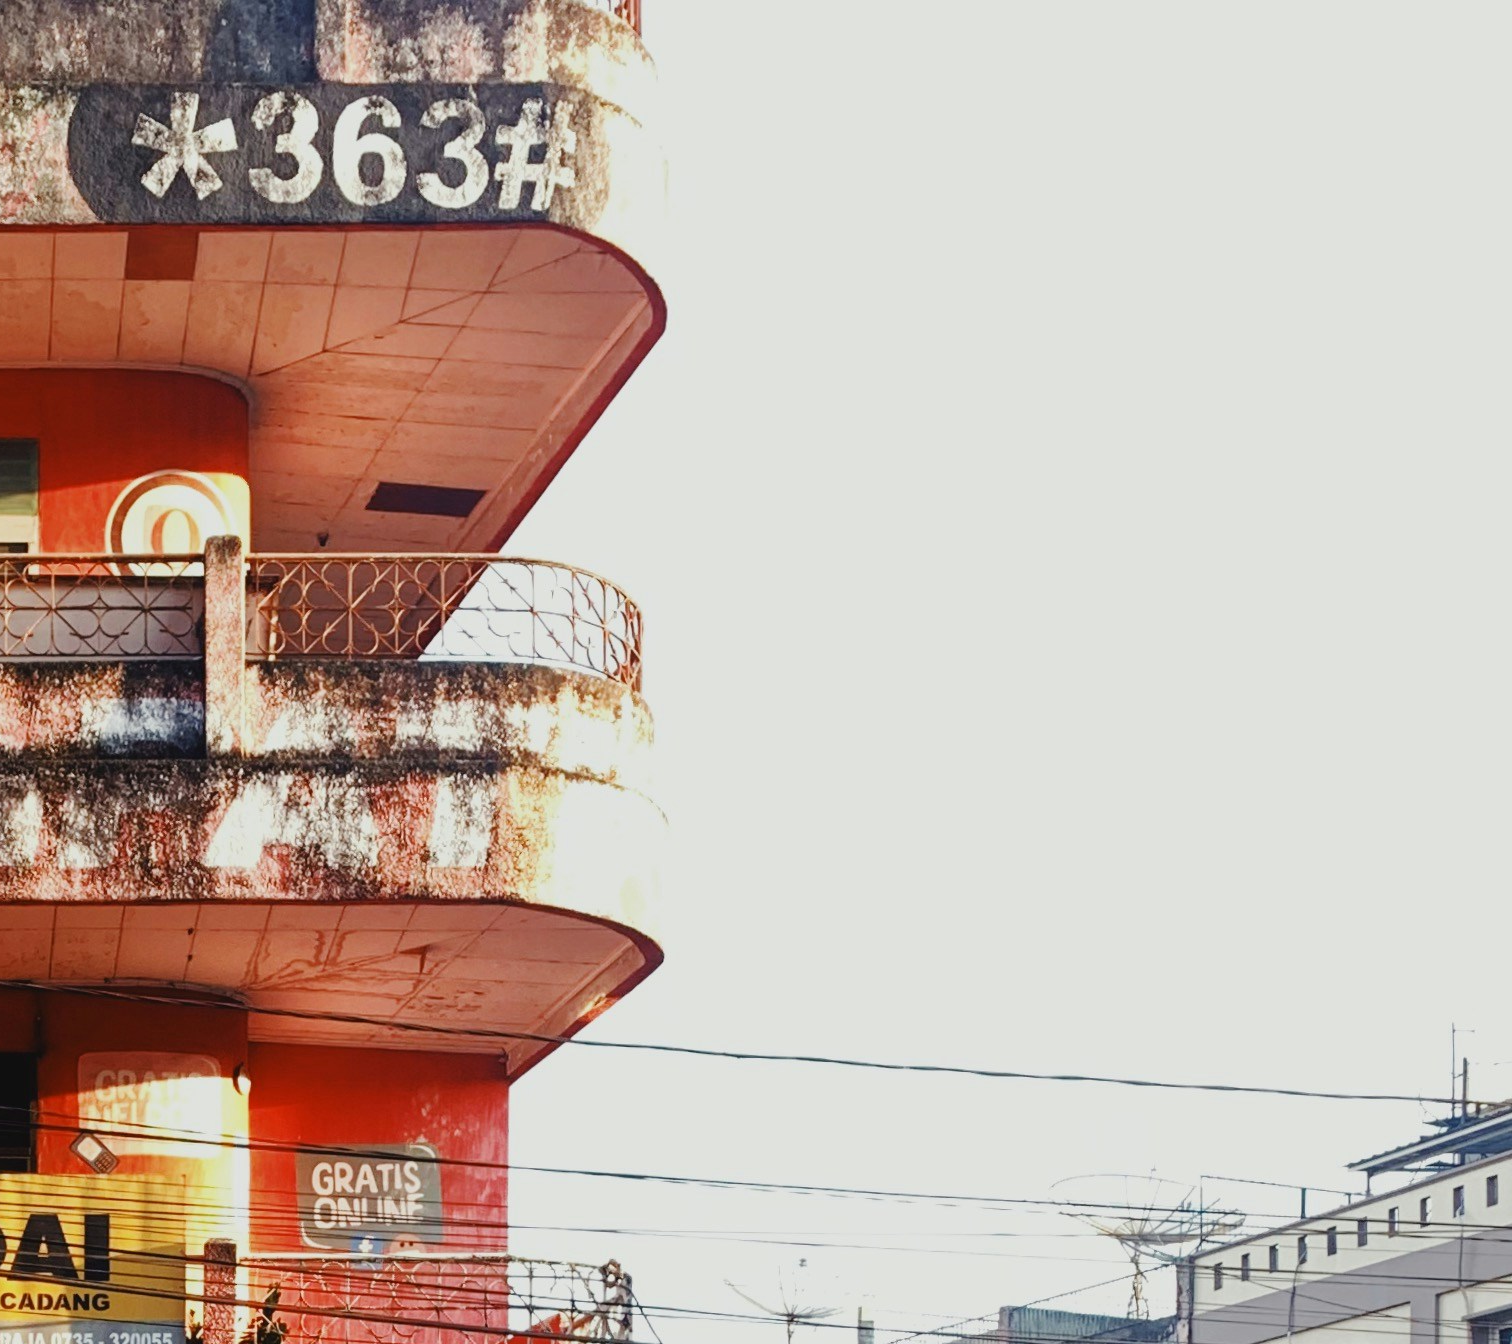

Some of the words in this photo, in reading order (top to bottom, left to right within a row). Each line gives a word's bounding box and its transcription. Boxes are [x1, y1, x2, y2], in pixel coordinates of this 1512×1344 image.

[312, 1161, 422, 1196] GRATIS
[313, 1193, 425, 1229] ONLINE
[0, 1292, 111, 1312] CADANG
